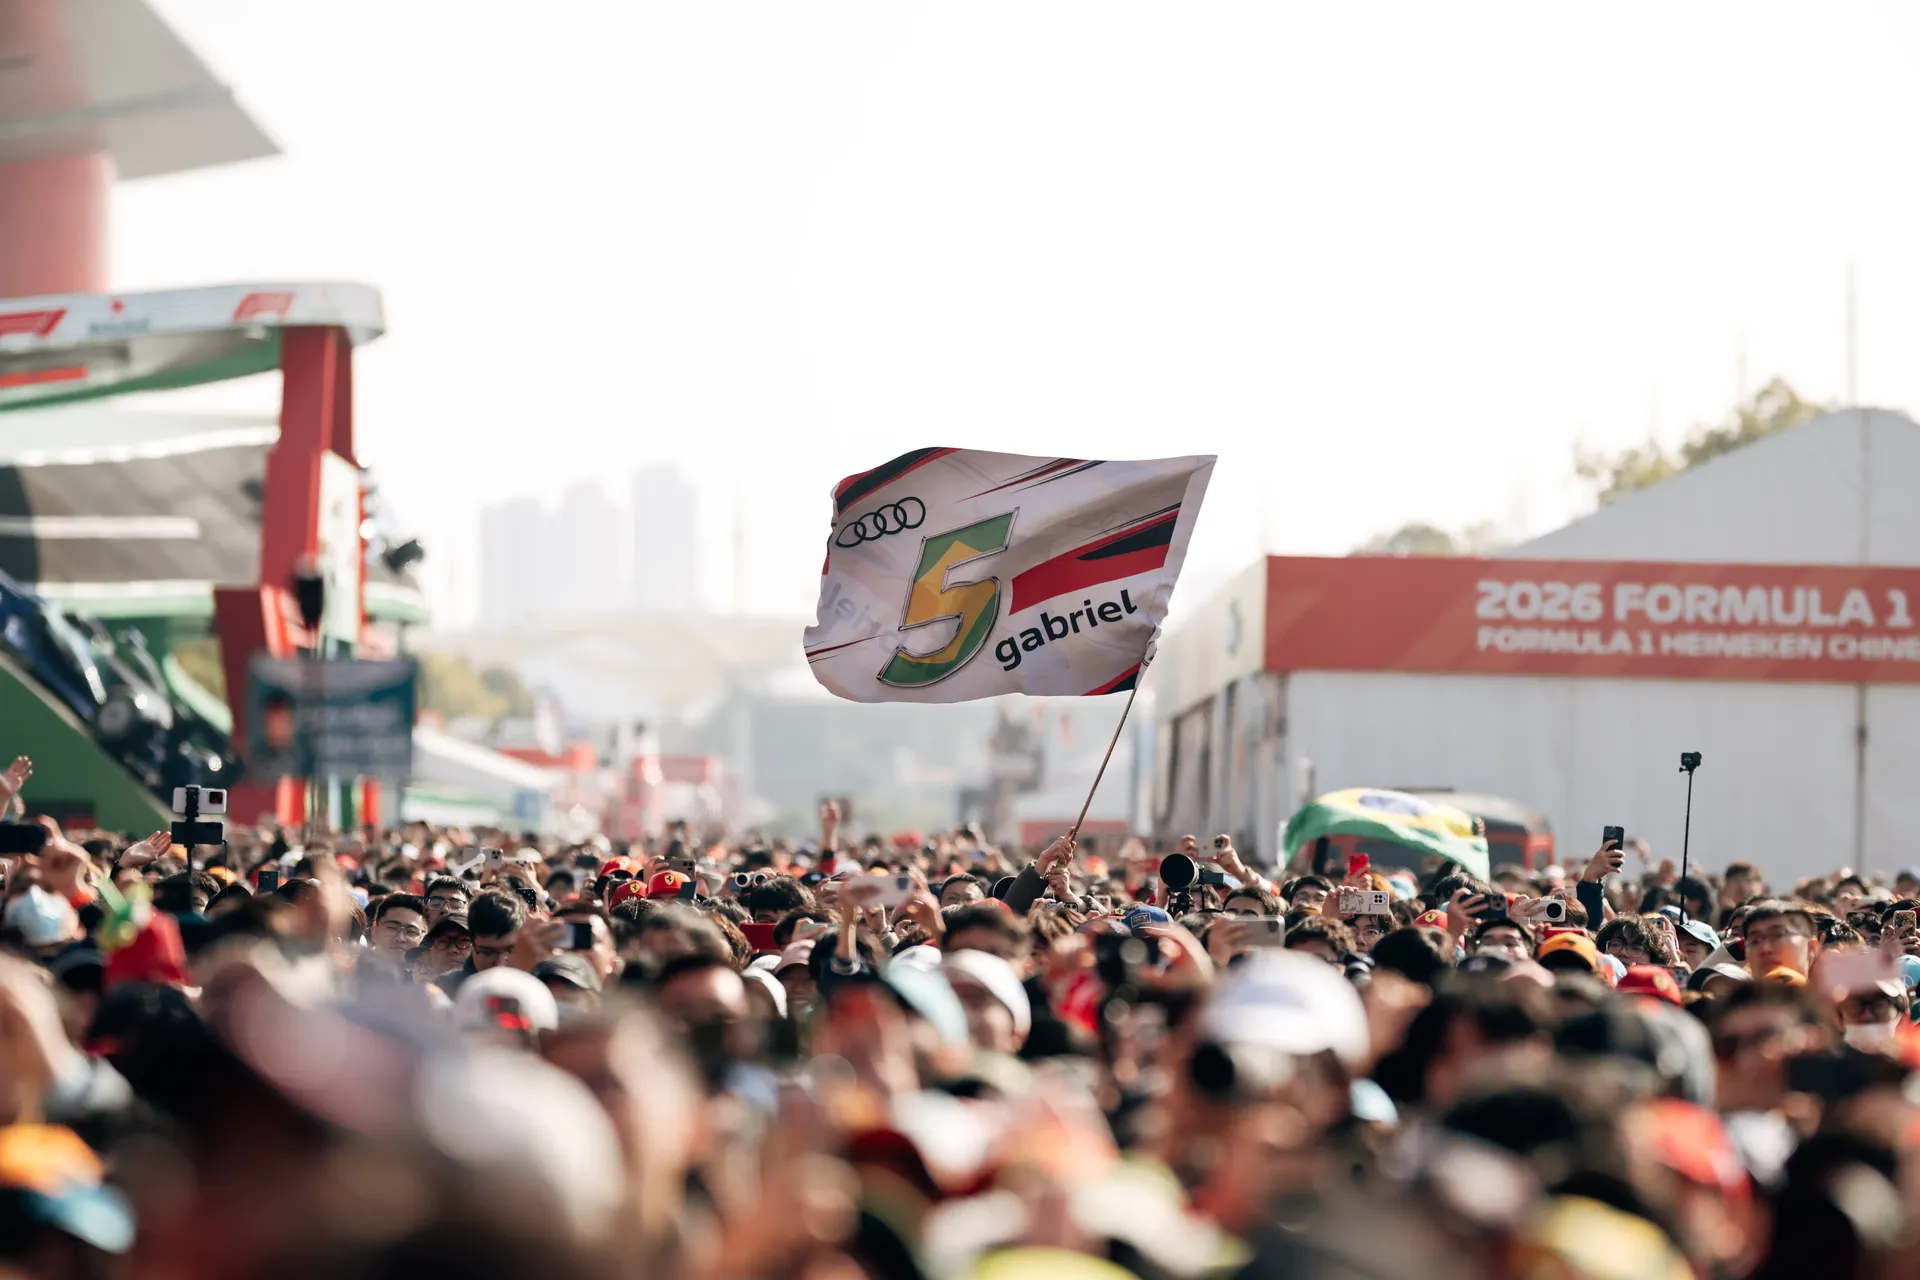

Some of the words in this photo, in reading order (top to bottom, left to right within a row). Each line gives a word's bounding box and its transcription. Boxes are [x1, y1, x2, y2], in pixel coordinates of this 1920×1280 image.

[875, 507, 1020, 688] 5
[995, 588, 1138, 672] gabriel
[1475, 579, 1603, 622] 2026
[1613, 584, 1876, 627] FORMULA
[1884, 588, 1914, 628] 1
[1476, 626, 1634, 655] FORMULA
[1638, 629, 1654, 655] 1
[1660, 631, 1823, 660] HEINEKEN
